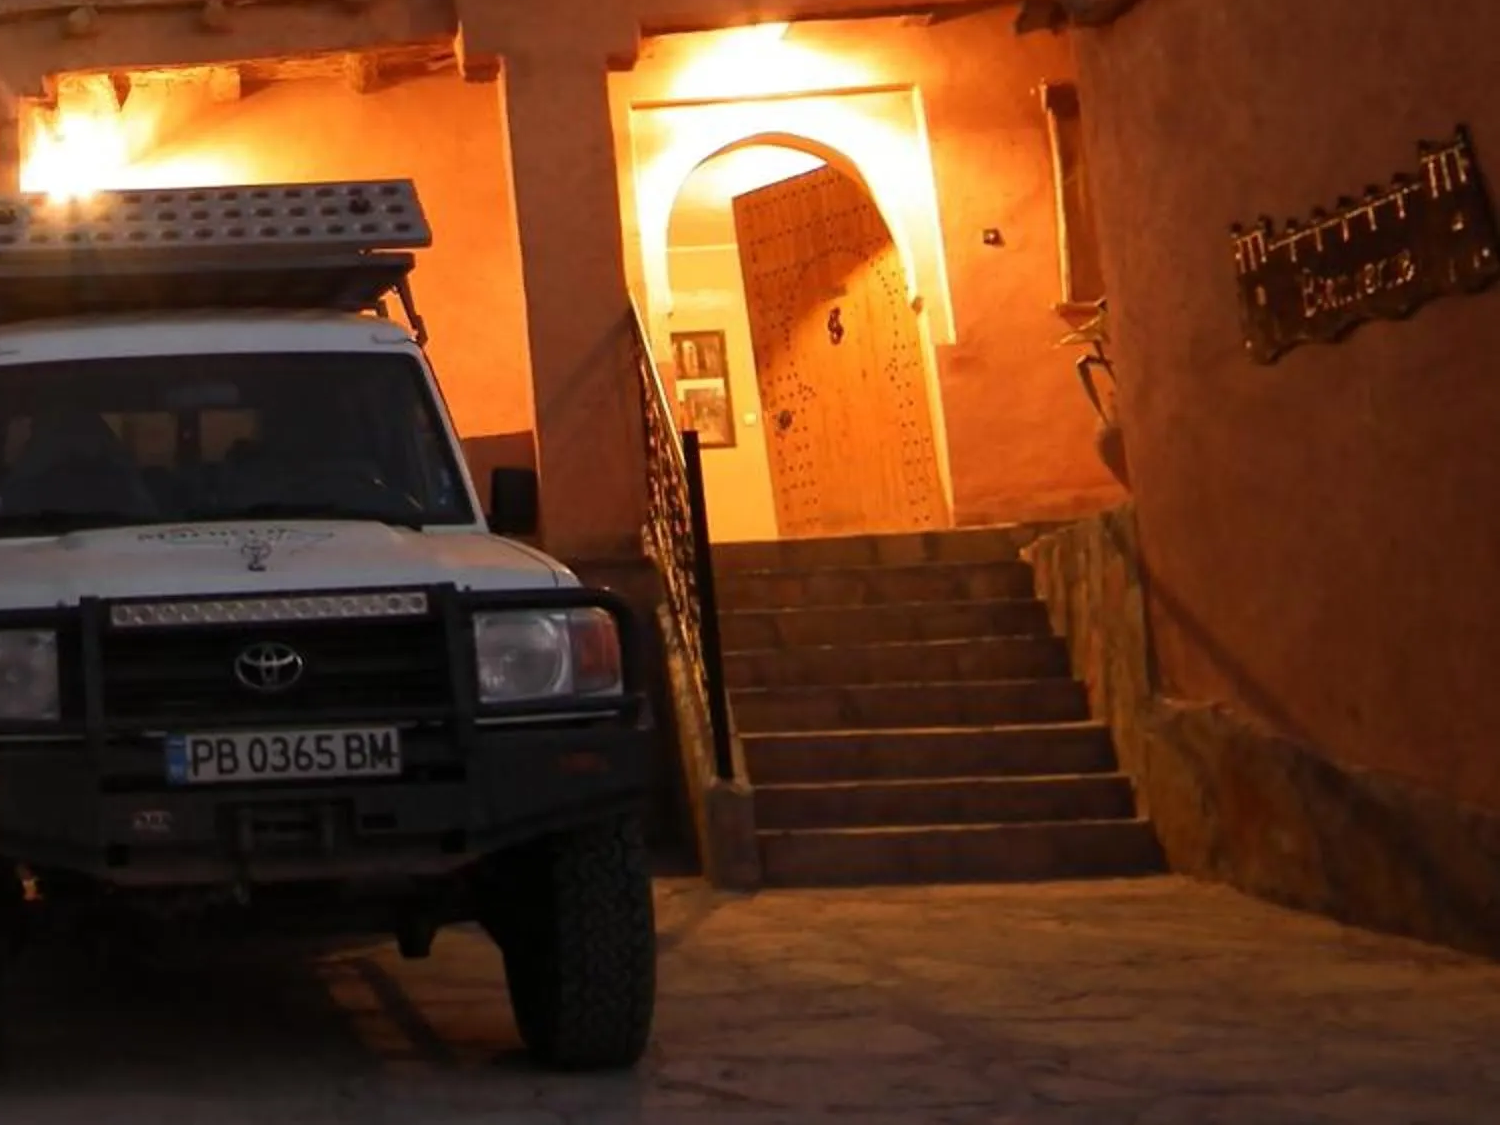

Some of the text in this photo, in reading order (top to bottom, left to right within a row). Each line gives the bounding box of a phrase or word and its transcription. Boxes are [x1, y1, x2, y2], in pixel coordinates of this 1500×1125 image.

[190, 738, 240, 777] PB
[247, 734, 337, 774] 0365
[343, 731, 398, 770] BM
